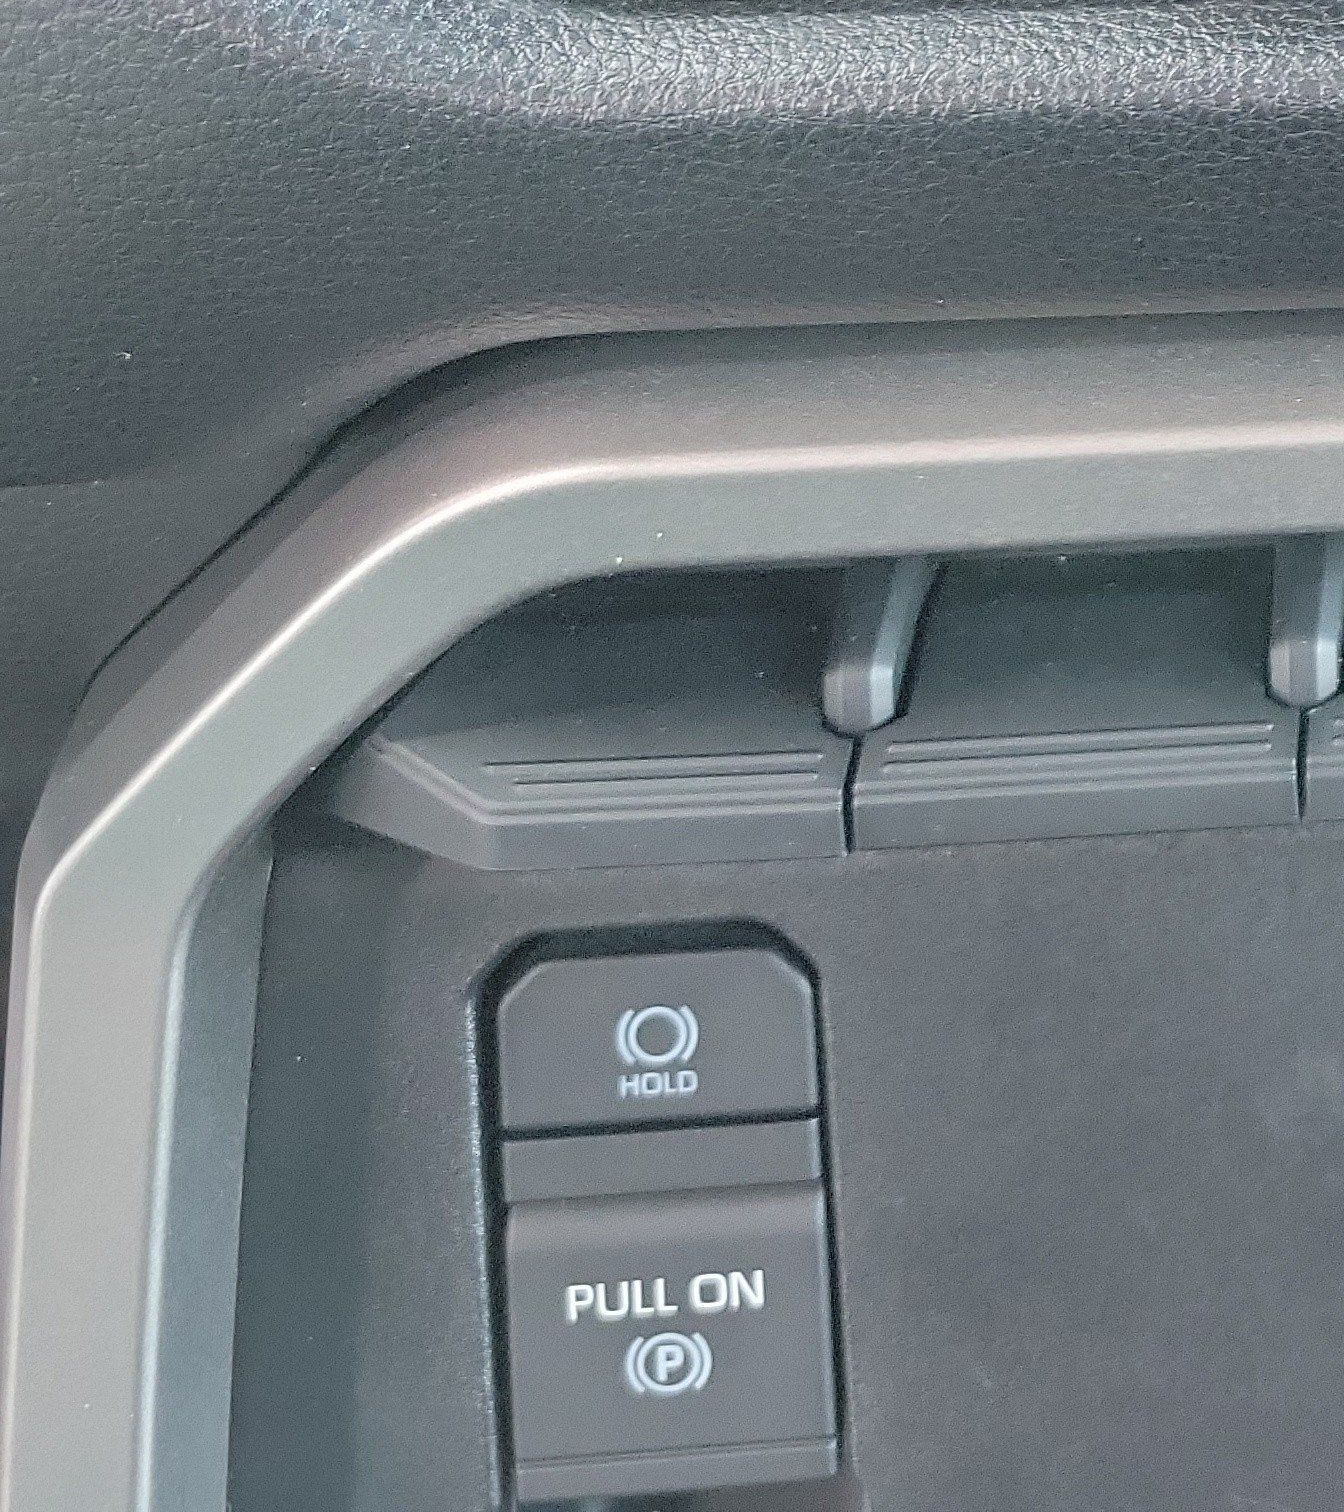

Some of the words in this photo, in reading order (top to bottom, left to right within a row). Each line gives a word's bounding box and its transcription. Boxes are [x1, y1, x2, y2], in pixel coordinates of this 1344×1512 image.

[618, 1070, 698, 1099] HOLD
[565, 1278, 678, 1323] PULL
[689, 1269, 766, 1314] ON
